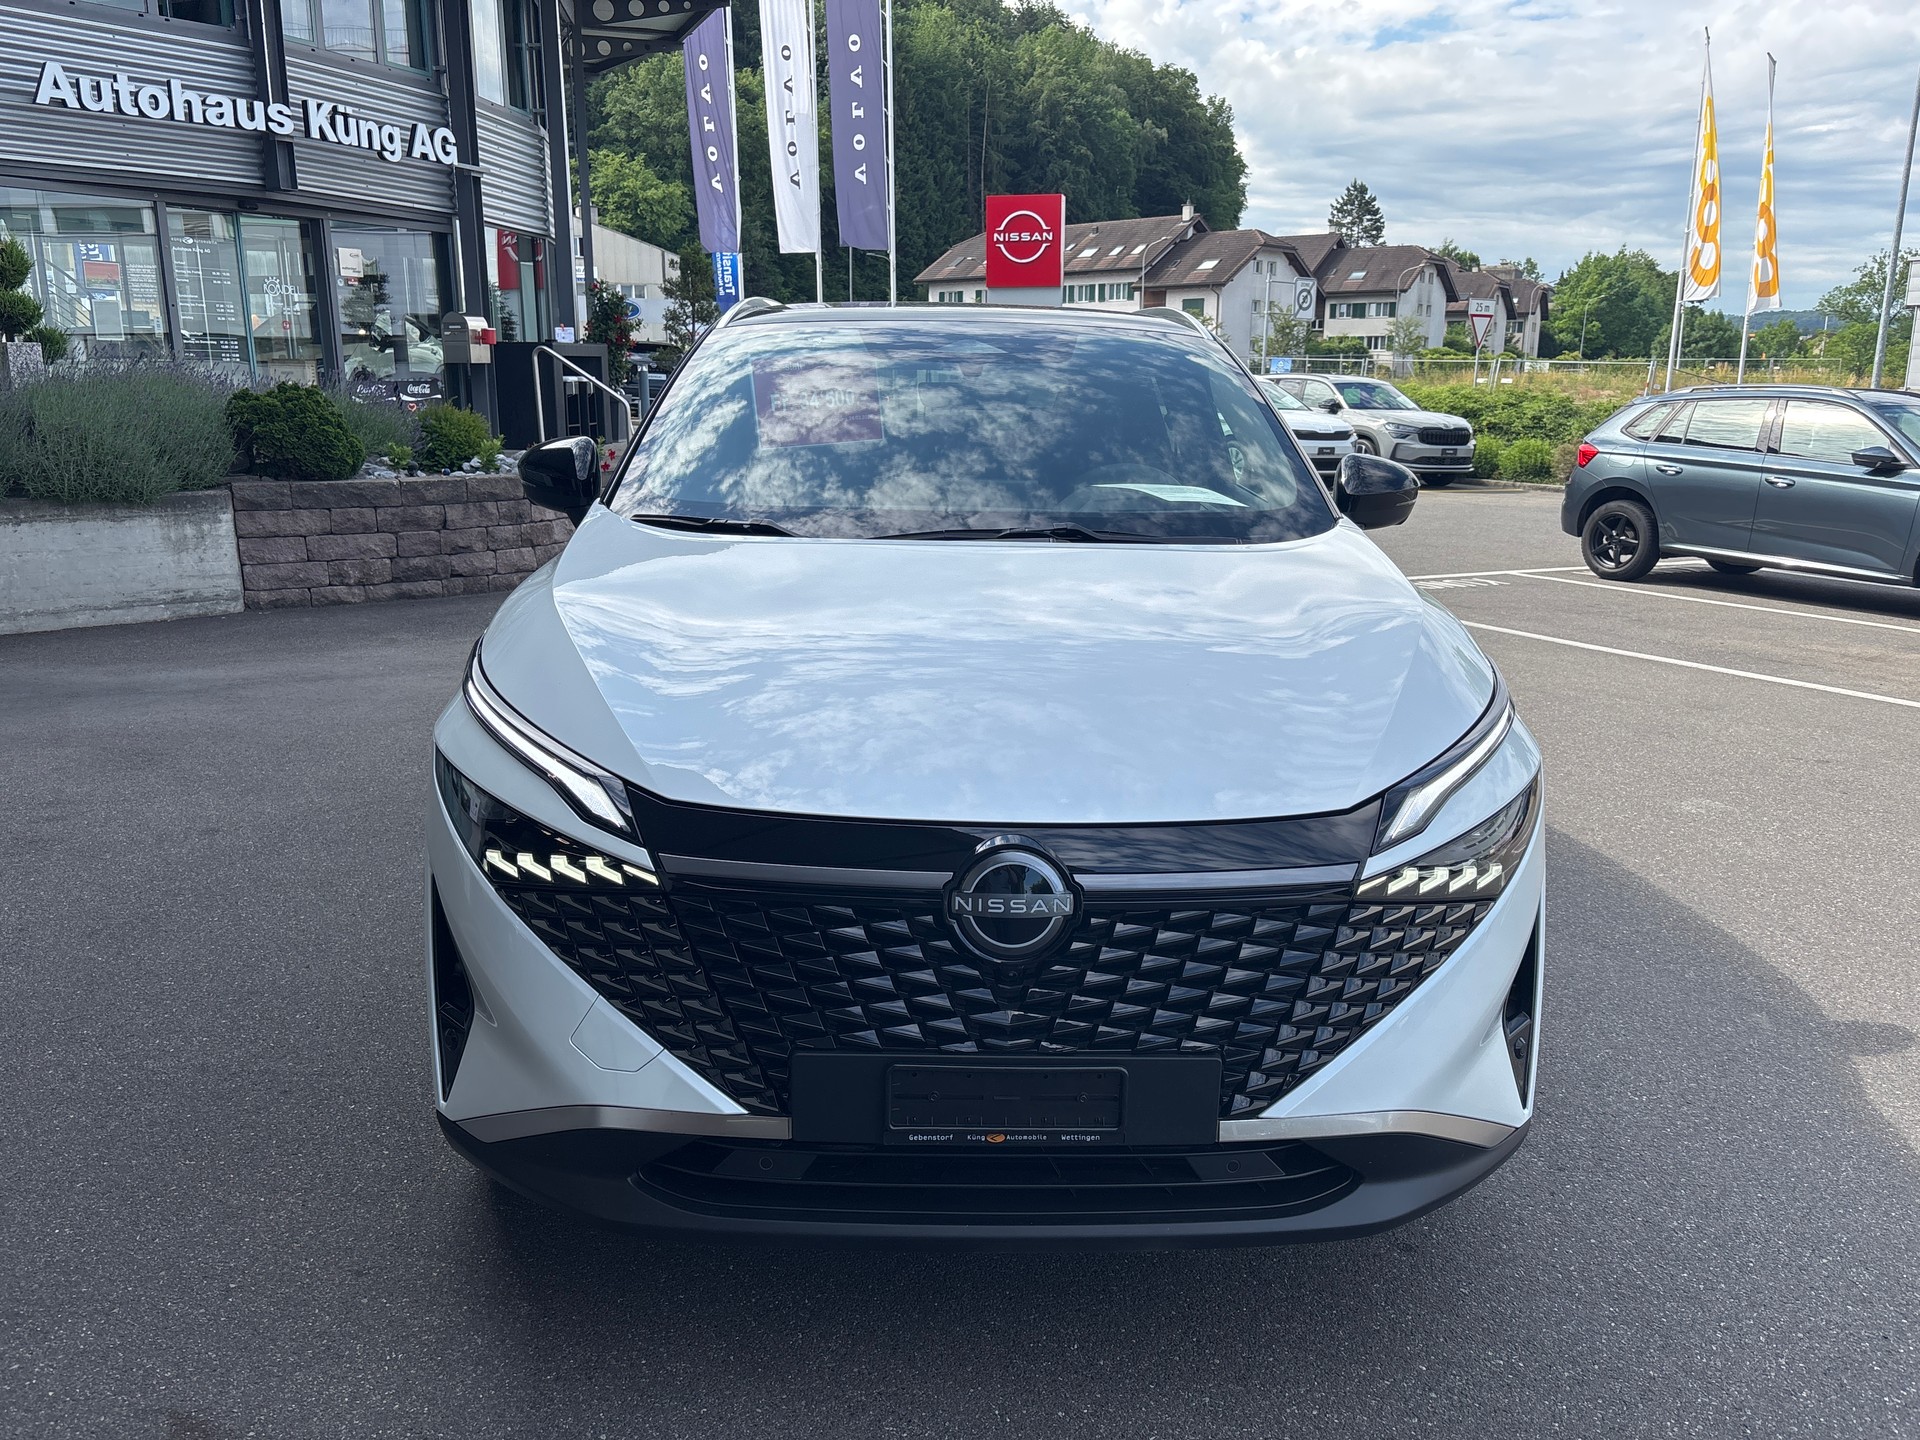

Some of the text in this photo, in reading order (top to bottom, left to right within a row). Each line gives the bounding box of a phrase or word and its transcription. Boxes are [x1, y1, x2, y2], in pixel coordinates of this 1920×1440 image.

[34, 61, 459, 165] Autohaus Küng AG
[993, 232, 1053, 242] NISSAN
[1475, 302, 1484, 312] 25
[954, 895, 1071, 914] NISSAN
[908, 1133, 1101, 1142] Gebenstorf Küng Automobile Wettingen
